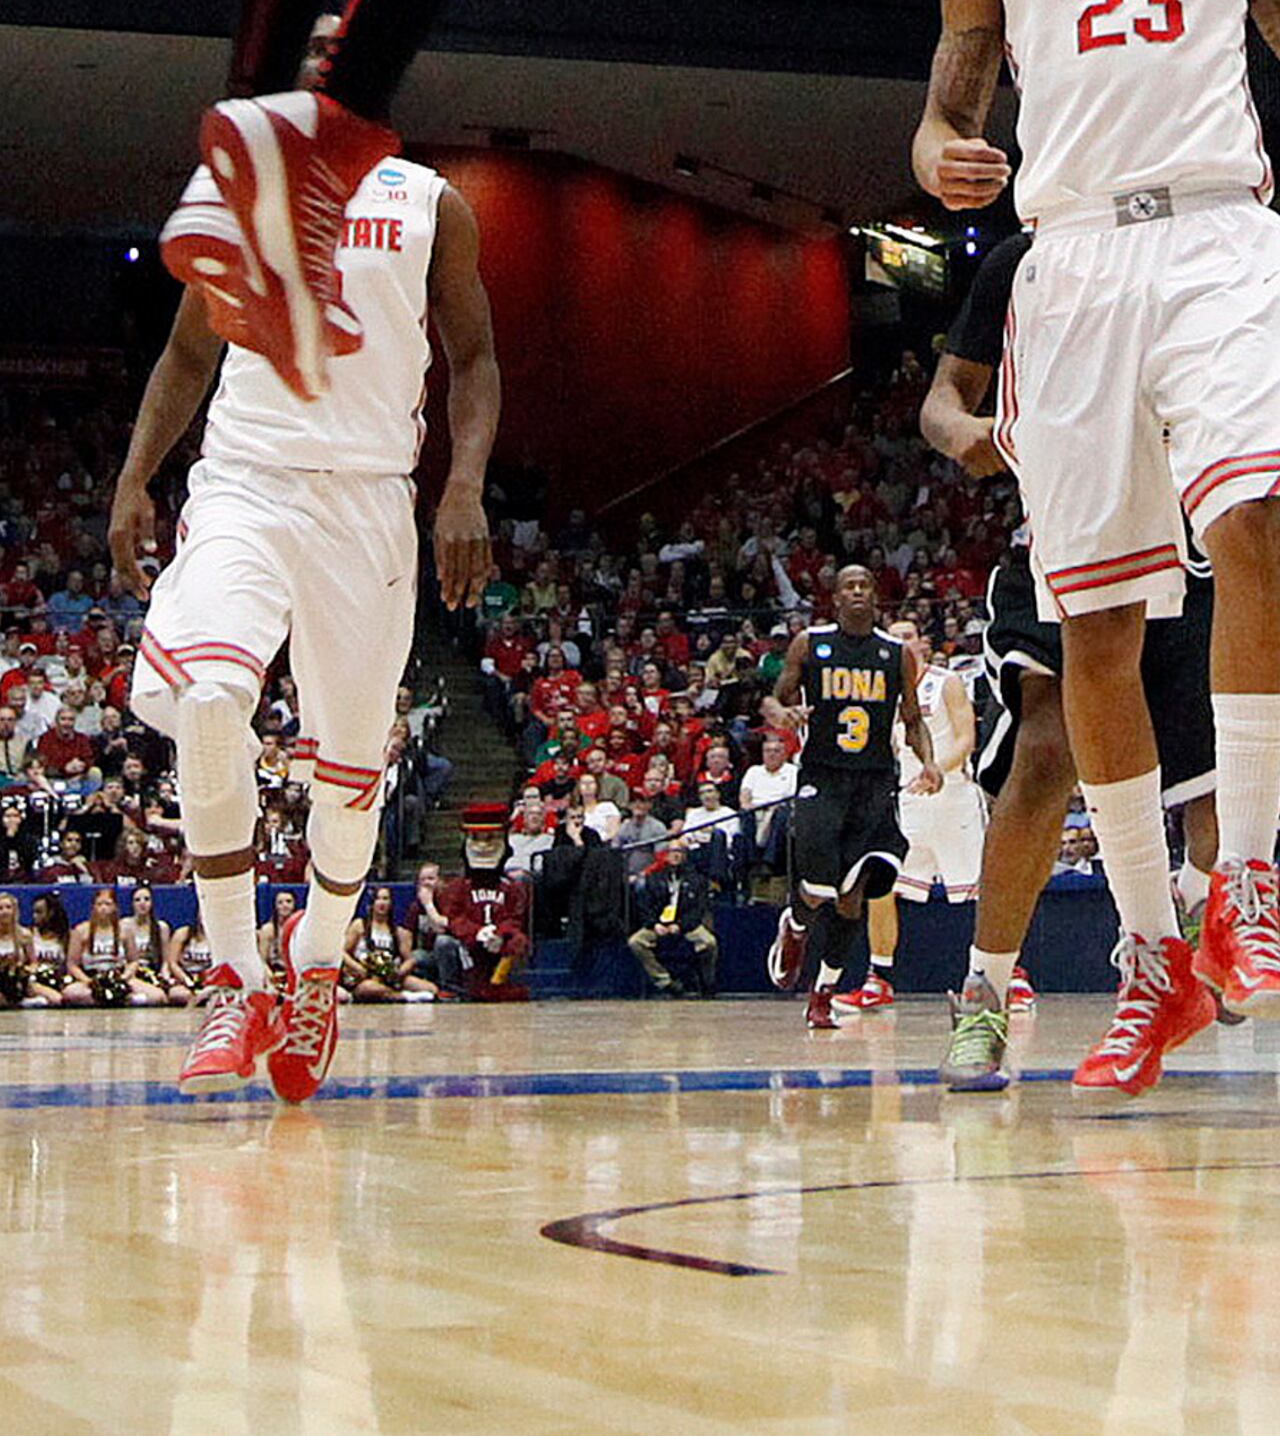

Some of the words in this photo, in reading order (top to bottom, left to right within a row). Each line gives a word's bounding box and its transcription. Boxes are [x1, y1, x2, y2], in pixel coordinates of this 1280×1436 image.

[340, 216, 403, 252] TATE
[820, 666, 887, 702] IONA
[836, 705, 871, 754] 3
[470, 888, 505, 905] IONA
[483, 903, 492, 924] 1
